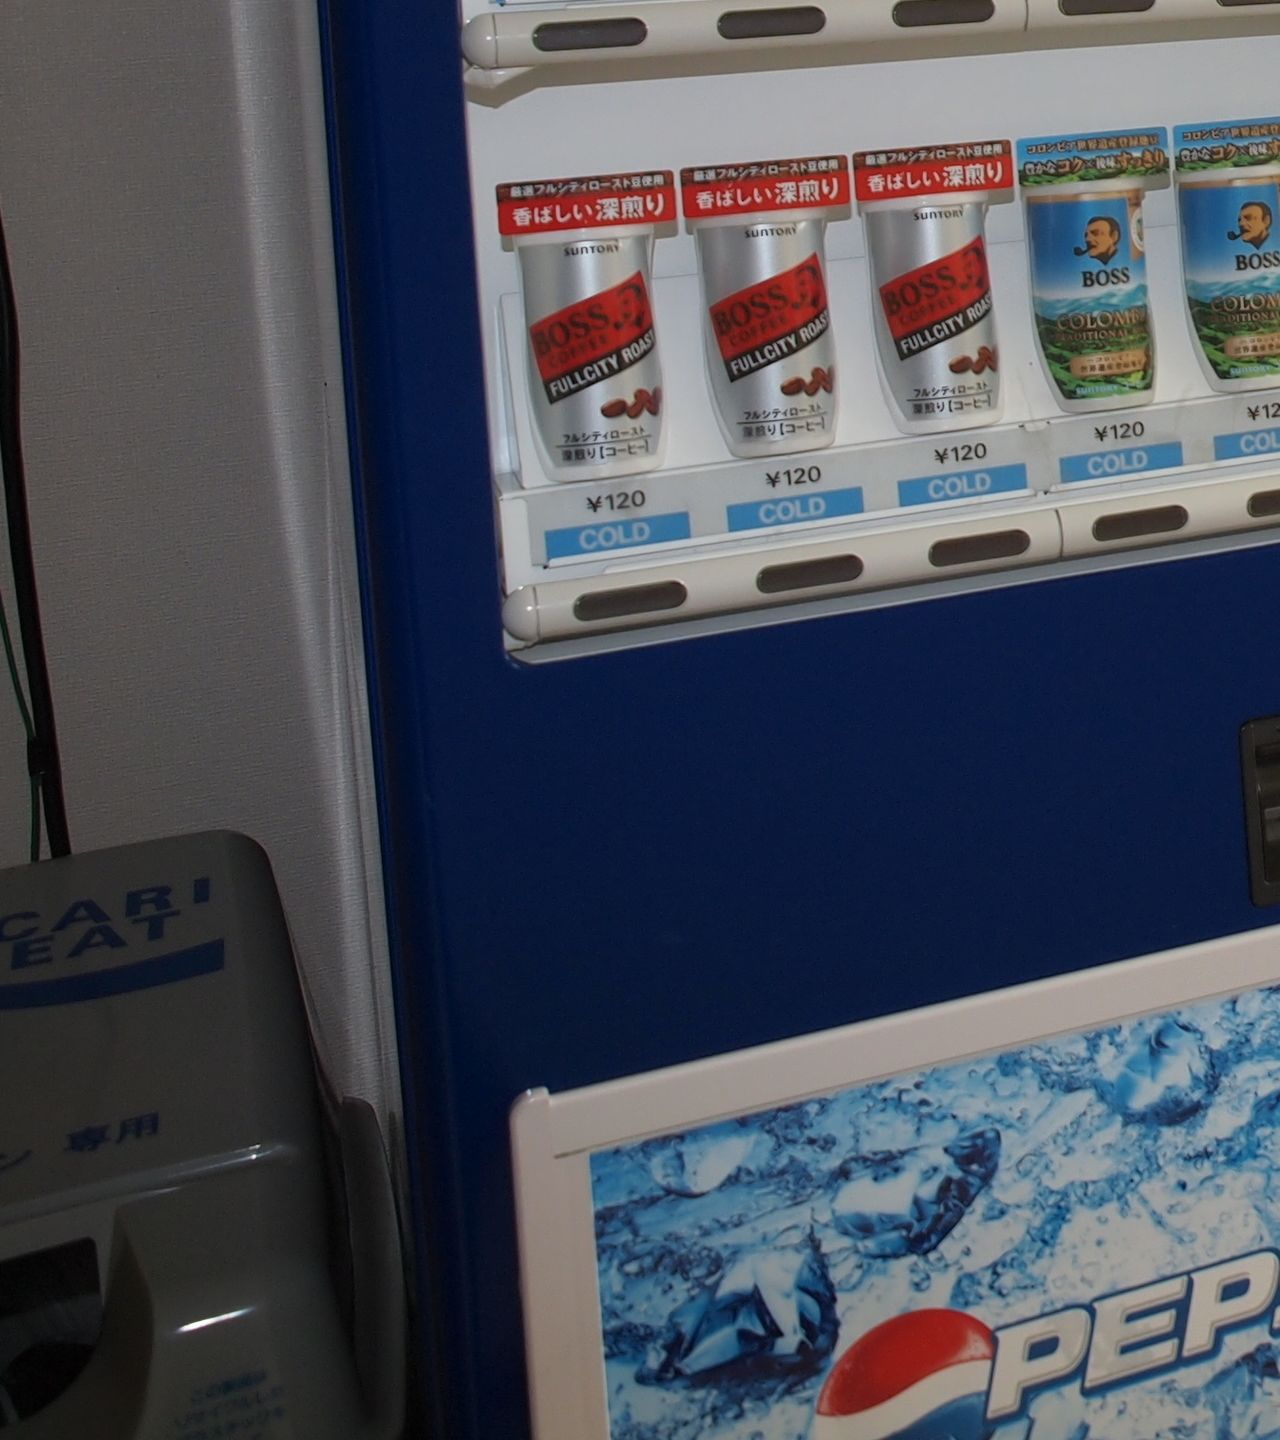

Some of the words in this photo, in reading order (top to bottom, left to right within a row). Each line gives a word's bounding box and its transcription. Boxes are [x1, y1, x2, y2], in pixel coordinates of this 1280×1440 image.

[867, 164, 1004, 192] 香ばしい深煎り
[696, 180, 839, 209] 香ばしい深煎り
[513, 196, 665, 226] 香ばしい深煎り
[1235, 251, 1280, 271] BOSS
[884, 267, 956, 310] BOSS
[1082, 267, 1130, 288] BOSS
[714, 287, 785, 331] BOSS
[536, 306, 610, 356] BOSS
[901, 313, 964, 353] FULLCITY
[731, 331, 797, 377] FULLCITY
[549, 353, 619, 398] FULLCITY
[743, 403, 822, 421] フルシティロースト
[562, 426, 645, 445] フルシティロースト
[1094, 421, 1144, 441] ¥120
[934, 443, 987, 464] ¥120
[765, 466, 821, 488] ¥120
[586, 490, 646, 513] ¥120
[758, 497, 826, 524] COLD
[579, 520, 650, 550] COLD
